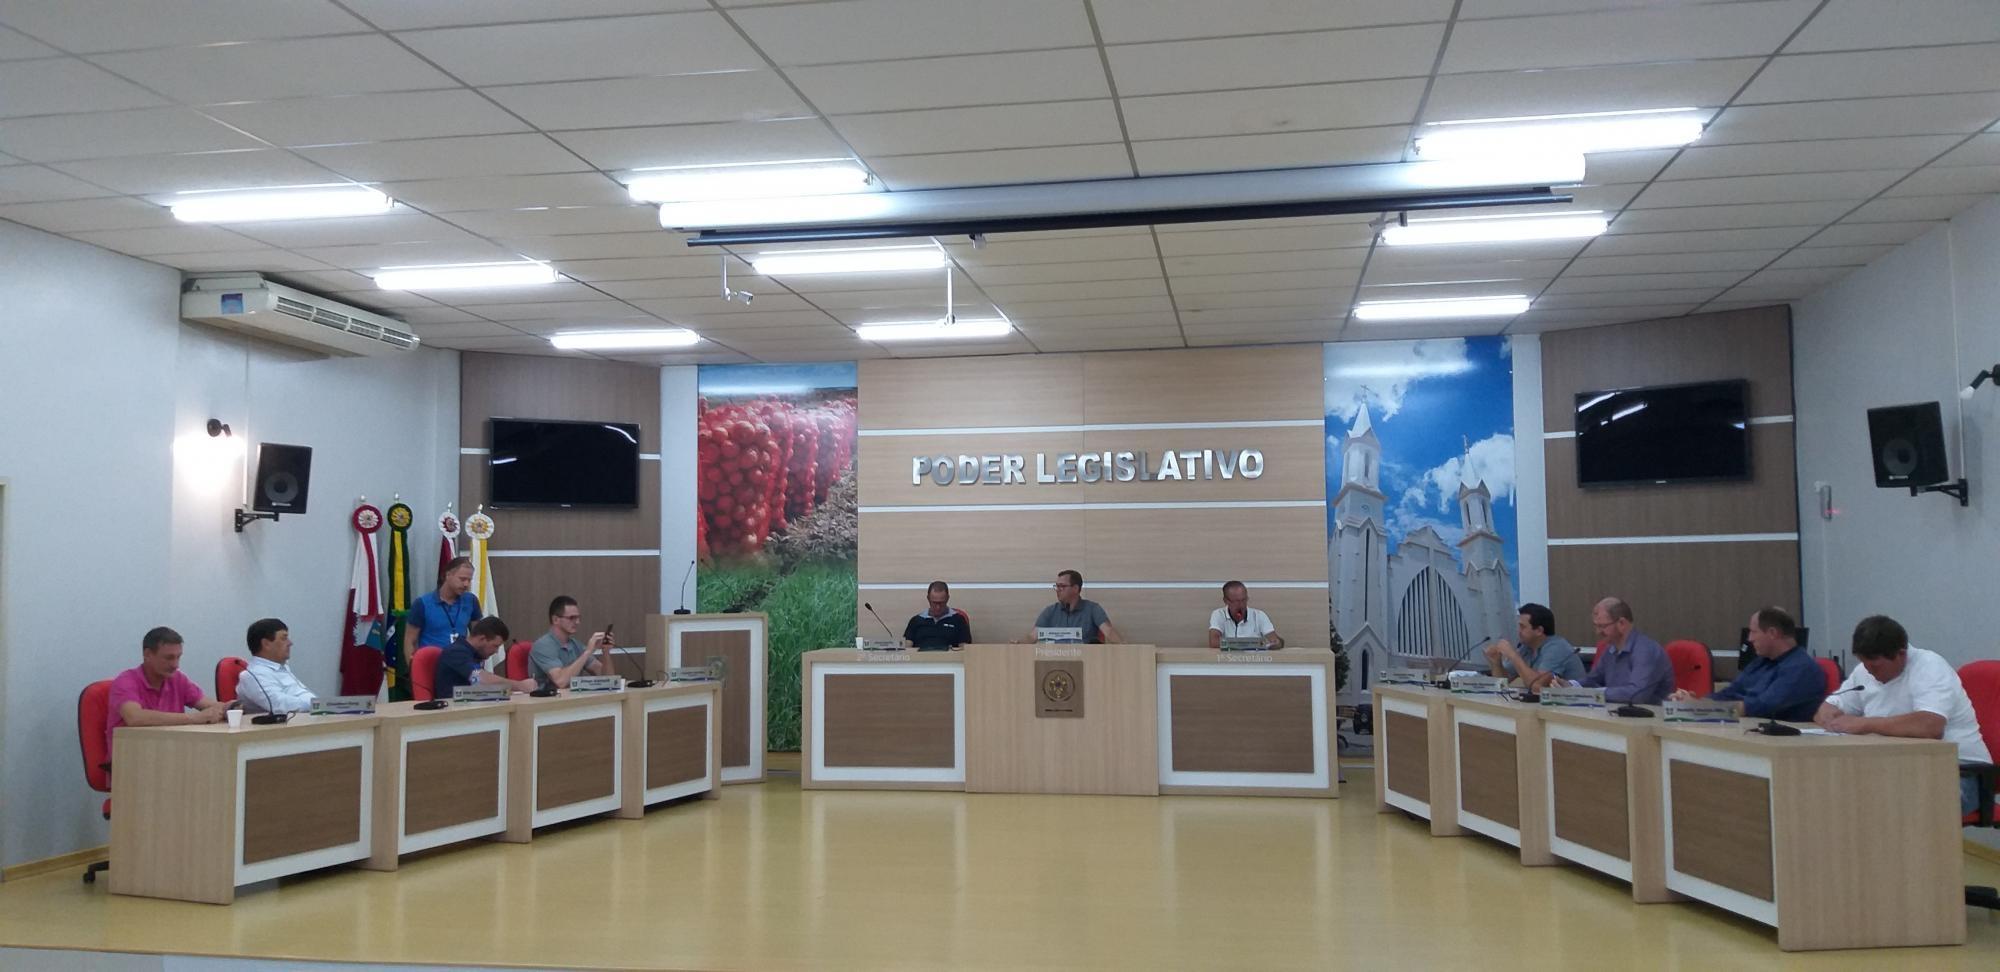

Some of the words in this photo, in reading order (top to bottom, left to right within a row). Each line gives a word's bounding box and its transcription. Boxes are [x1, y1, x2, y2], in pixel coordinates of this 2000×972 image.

[912, 454, 1026, 486] PODER
[1036, 449, 1264, 484] LEGISLATIVO
[1035, 647, 1083, 657] Presidente
